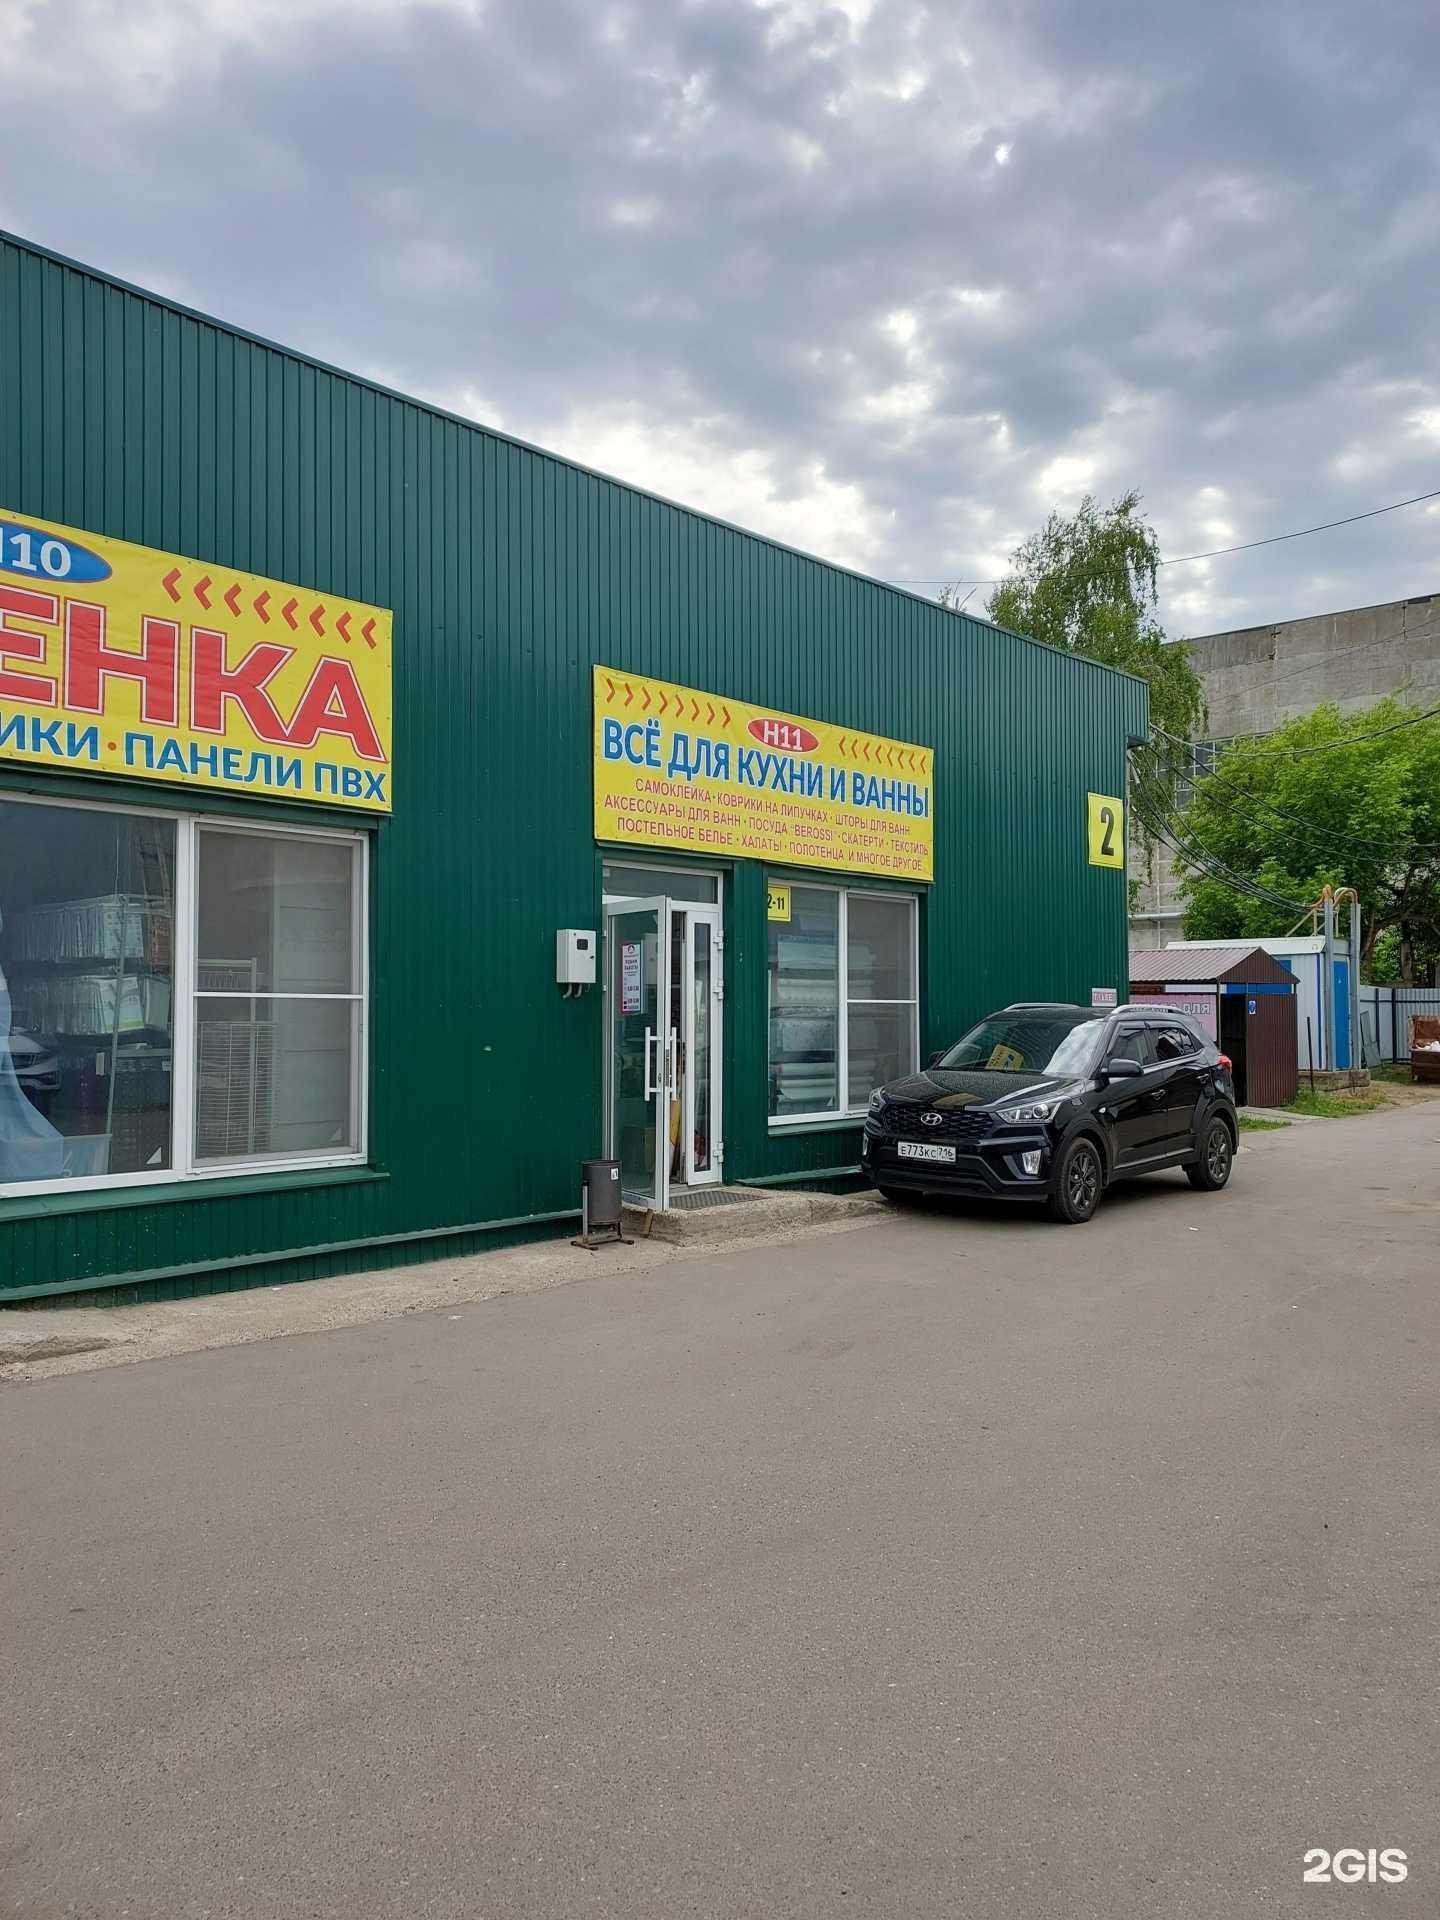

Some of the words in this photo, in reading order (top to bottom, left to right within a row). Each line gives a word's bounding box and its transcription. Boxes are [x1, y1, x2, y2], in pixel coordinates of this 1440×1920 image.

[0, 527, 71, 577] 10
[763, 720, 803, 751] Н11
[124, 731, 303, 791] ПАНЕЛИ
[314, 761, 386, 802] ПВХ
[603, 717, 662, 768] ВСЁ
[667, 732, 730, 782] ДЛЯ
[737, 747, 823, 799] КУХНИ
[829, 767, 846, 803] И
[852, 771, 929, 818] ВАННЫ
[604, 794, 686, 819] АКСЕССУАРЫ
[687, 806, 710, 822] ДЛЯ
[713, 810, 741, 828] ВАНН
[749, 816, 788, 836] ПОСУДА
[841, 831, 884, 849] СКАТЕРТИ
[891, 839, 929, 856] ТЕКСТИЛЬ
[717, 791, 763, 813] КОВРИКИ
[765, 800, 779, 815] НА
[780, 803, 829, 823] ЛИПУЧКАХ
[835, 813, 869, 829] ШТОРЫ
[870, 819, 887, 832] ДЛЯ
[888, 822, 910, 836] ВАНН
[1100, 806, 1115, 857] 2
[617, 817, 695, 838] ПОСТЕЛЬНОЕ
[698, 828, 733, 846] БЕЛЬЕ
[741, 834, 782, 853] ХАЛАТЫ
[789, 841, 845, 862] ПОЛОТЕНЦА
[848, 849, 855, 862] И
[856, 851, 891, 867] МНОГОЕ
[892, 856, 923, 871] ДРУГОЕ
